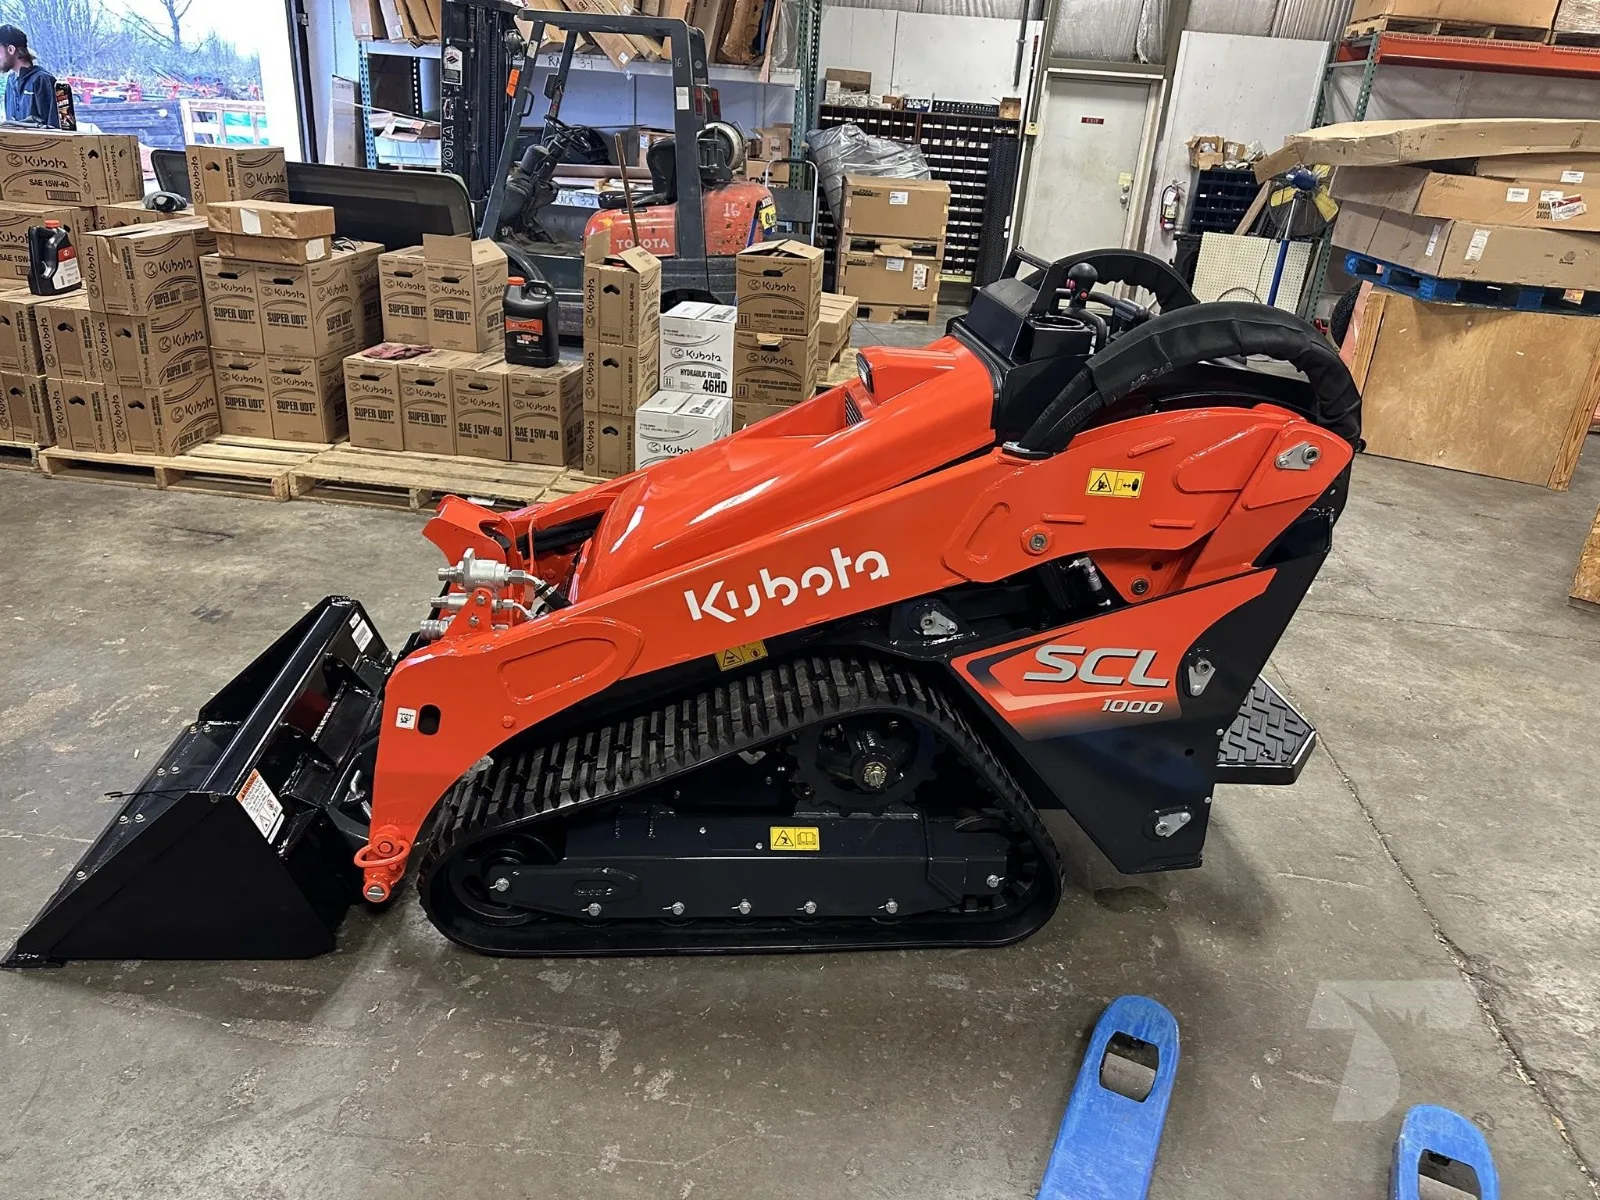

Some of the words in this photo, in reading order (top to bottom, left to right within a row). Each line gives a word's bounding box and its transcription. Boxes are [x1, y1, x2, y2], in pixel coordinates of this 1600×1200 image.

[24, 155, 68, 169] Kubota
[80, 146, 88, 180] Kubota
[191, 156, 201, 189] Kubota
[256, 172, 285, 185] Kubota
[29, 178, 43, 187] SAE
[44, 179, 69, 188] 15W-40
[616, 238, 669, 249] TOOTA
[86, 246, 97, 282] Kubota
[158, 257, 193, 273] Kubota
[221, 282, 252, 293] Kubota
[327, 282, 349, 297] Kubota
[396, 280, 426, 291] Kubota
[441, 286, 470, 296] Kubota
[762, 280, 797, 292] Kubota
[274, 288, 305, 299] Kubota
[213, 307, 237, 319] SUPER
[388, 303, 410, 315] SUPER
[433, 308, 454, 320] SUPER
[267, 312, 289, 324] SUPER
[40, 317, 52, 352] Kubota
[97, 322, 109, 356] Kubota
[172, 329, 205, 346] Kubota
[686, 349, 722, 362] Kubota
[760, 354, 795, 366] Kubota
[231, 373, 263, 384] Kubota
[680, 368, 707, 378] HYDRAULIC
[707, 371, 721, 380] FLUID
[283, 377, 314, 388] Kubota
[702, 379, 728, 394] 46HD
[362, 384, 393, 395] Kubota
[415, 388, 446, 399] Kubota
[53, 390, 64, 423] Kubota
[184, 396, 215, 415] Kubota
[224, 396, 247, 409] SUPER
[276, 399, 298, 412] SUPER
[470, 397, 500, 409] Kubota
[526, 401, 556, 413] Kubota
[112, 394, 123, 427] Kubota
[354, 407, 377, 419] SUPER
[407, 410, 430, 423] SUPER
[458, 422, 472, 433] SAE
[473, 424, 503, 437] 15W-40
[514, 426, 528, 437] SAE
[529, 428, 559, 441] 15W-40
[683, 546, 890, 623] Kubota
[1023, 644, 1170, 688] SCL
[1101, 698, 1164, 714] 1000
